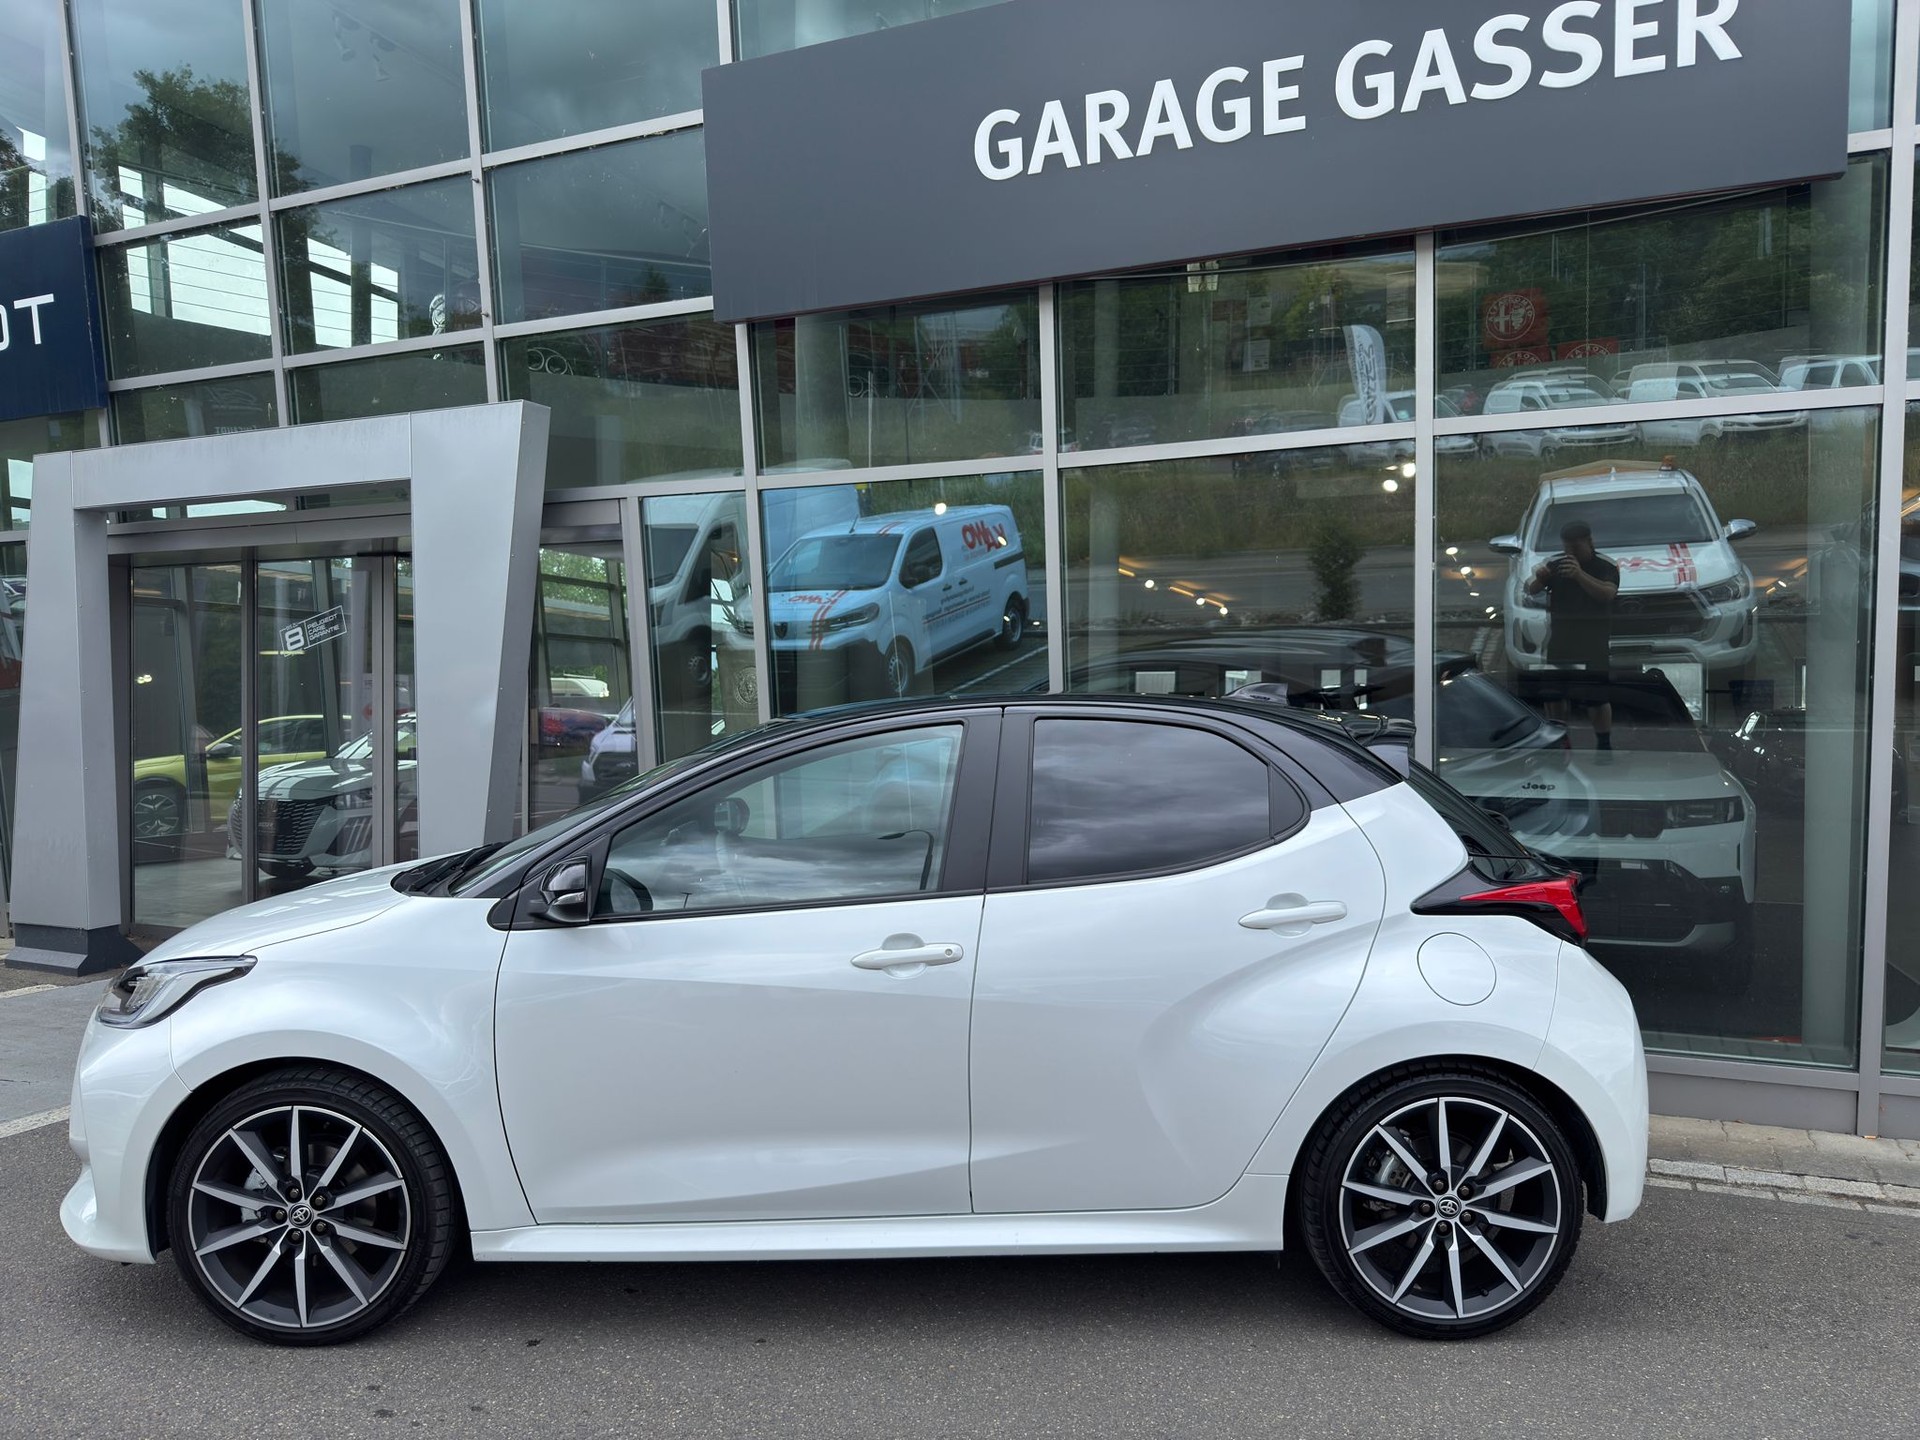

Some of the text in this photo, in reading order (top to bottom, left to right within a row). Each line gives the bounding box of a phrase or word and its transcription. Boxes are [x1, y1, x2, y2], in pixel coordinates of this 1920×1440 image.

[974, 0, 1742, 181] GARAGE GASSER
[0, 293, 54, 351] T
[307, 613, 338, 630] PEUGEOT
[308, 624, 326, 636] CARE
[285, 627, 305, 651] 8
[1521, 782, 1556, 792] Jeep
